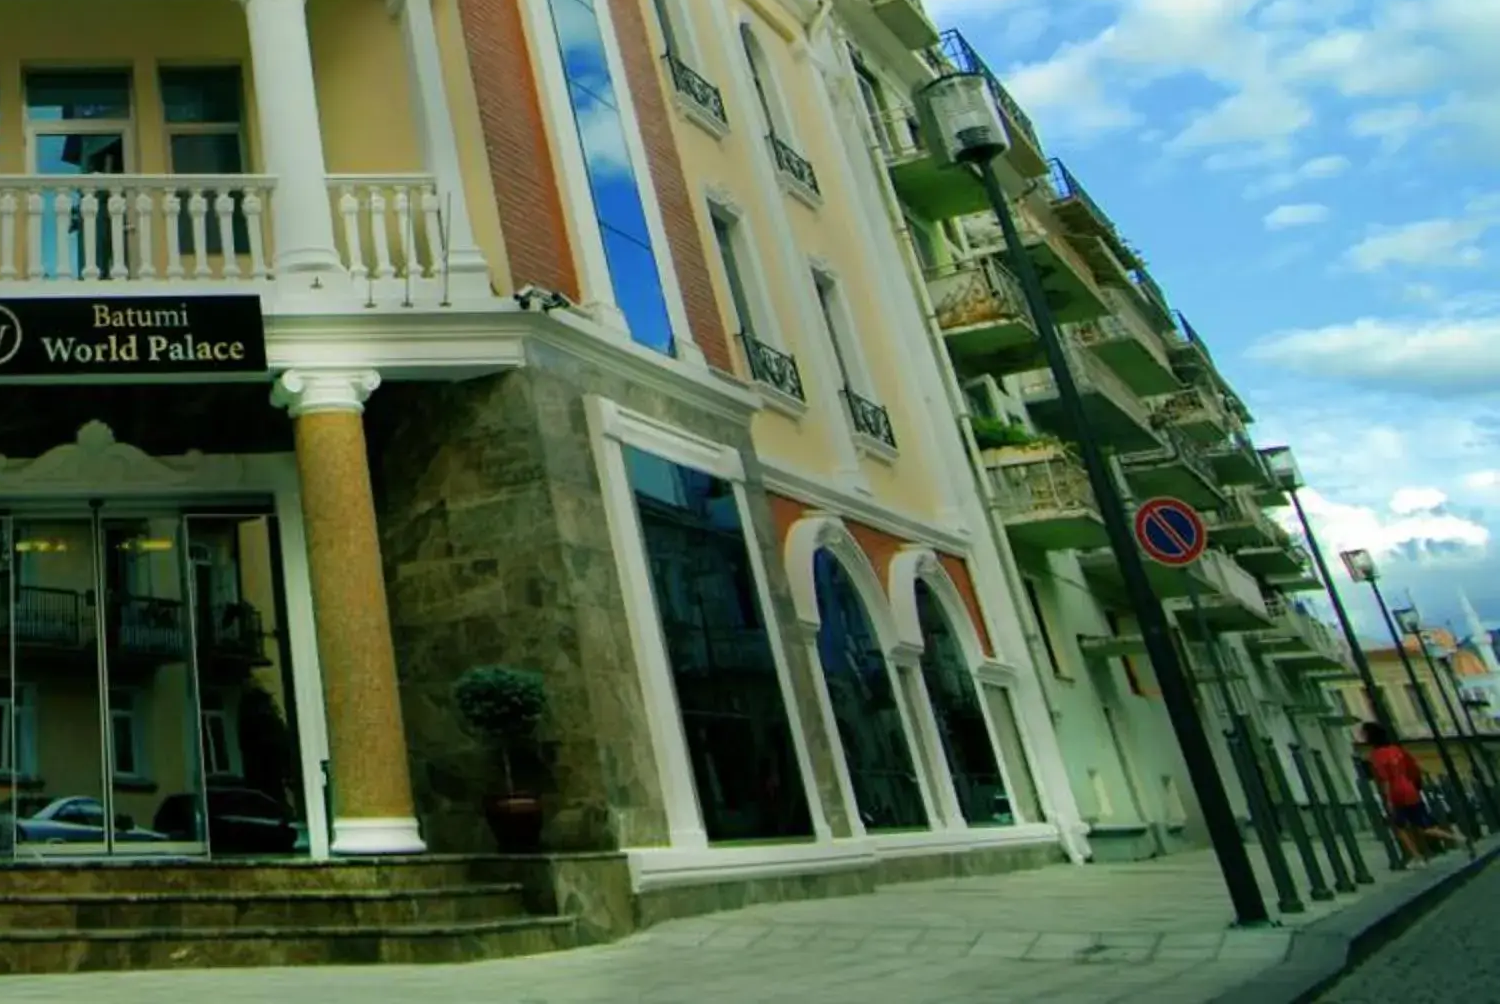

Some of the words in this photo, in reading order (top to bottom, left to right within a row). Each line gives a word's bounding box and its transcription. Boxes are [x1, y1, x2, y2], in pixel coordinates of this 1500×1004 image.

[92, 303, 188, 328] Batumi
[41, 335, 139, 363] World
[148, 334, 245, 362] Palace
